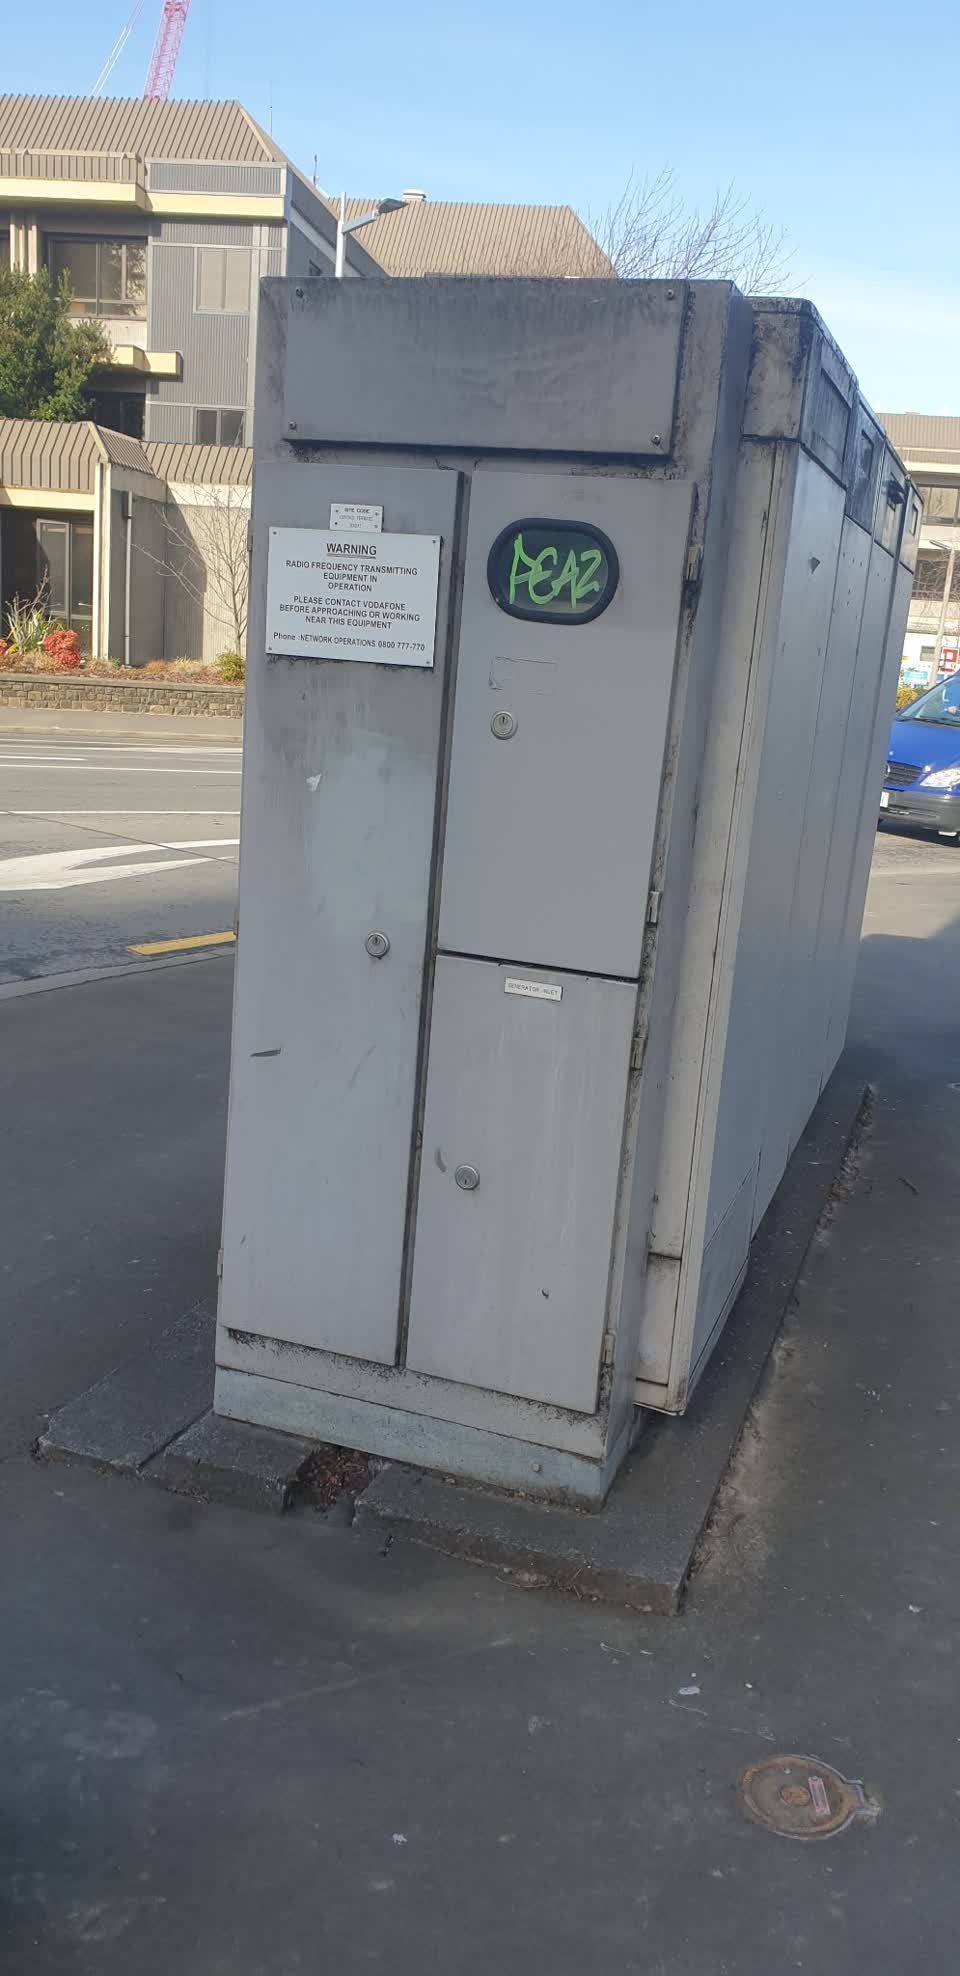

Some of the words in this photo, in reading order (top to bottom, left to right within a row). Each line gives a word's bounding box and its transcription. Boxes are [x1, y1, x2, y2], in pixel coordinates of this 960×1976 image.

[326, 543, 377, 556] WARNING
[286, 560, 310, 569] RADIO
[311, 562, 358, 572] FREQUENCY
[360, 564, 418, 576] TRANSMITTING
[323, 572, 368, 583] EQUIPMENT
[370, 575, 378, 583] IN
[328, 582, 372, 592] OPERATION
[294, 596, 322, 605] PLEASE
[325, 598, 360, 608] CONTACT
[362, 601, 406, 611] VODAFONE
[280, 604, 310, 614] BEFORE
[312, 606, 368, 618] APPROACHING
[369, 611, 380, 619] OR
[382, 612, 420, 622] WORKING
[306, 616, 326, 624] NEAR
[328, 617, 345, 626] THIS
[346, 618, 392, 629] EQUIPMENT
[274, 632, 296, 640] Phone
[334, 636, 376, 648] OPERATIONS
[378, 640, 395, 649] 0800
[397, 642, 425, 652] 777-770
